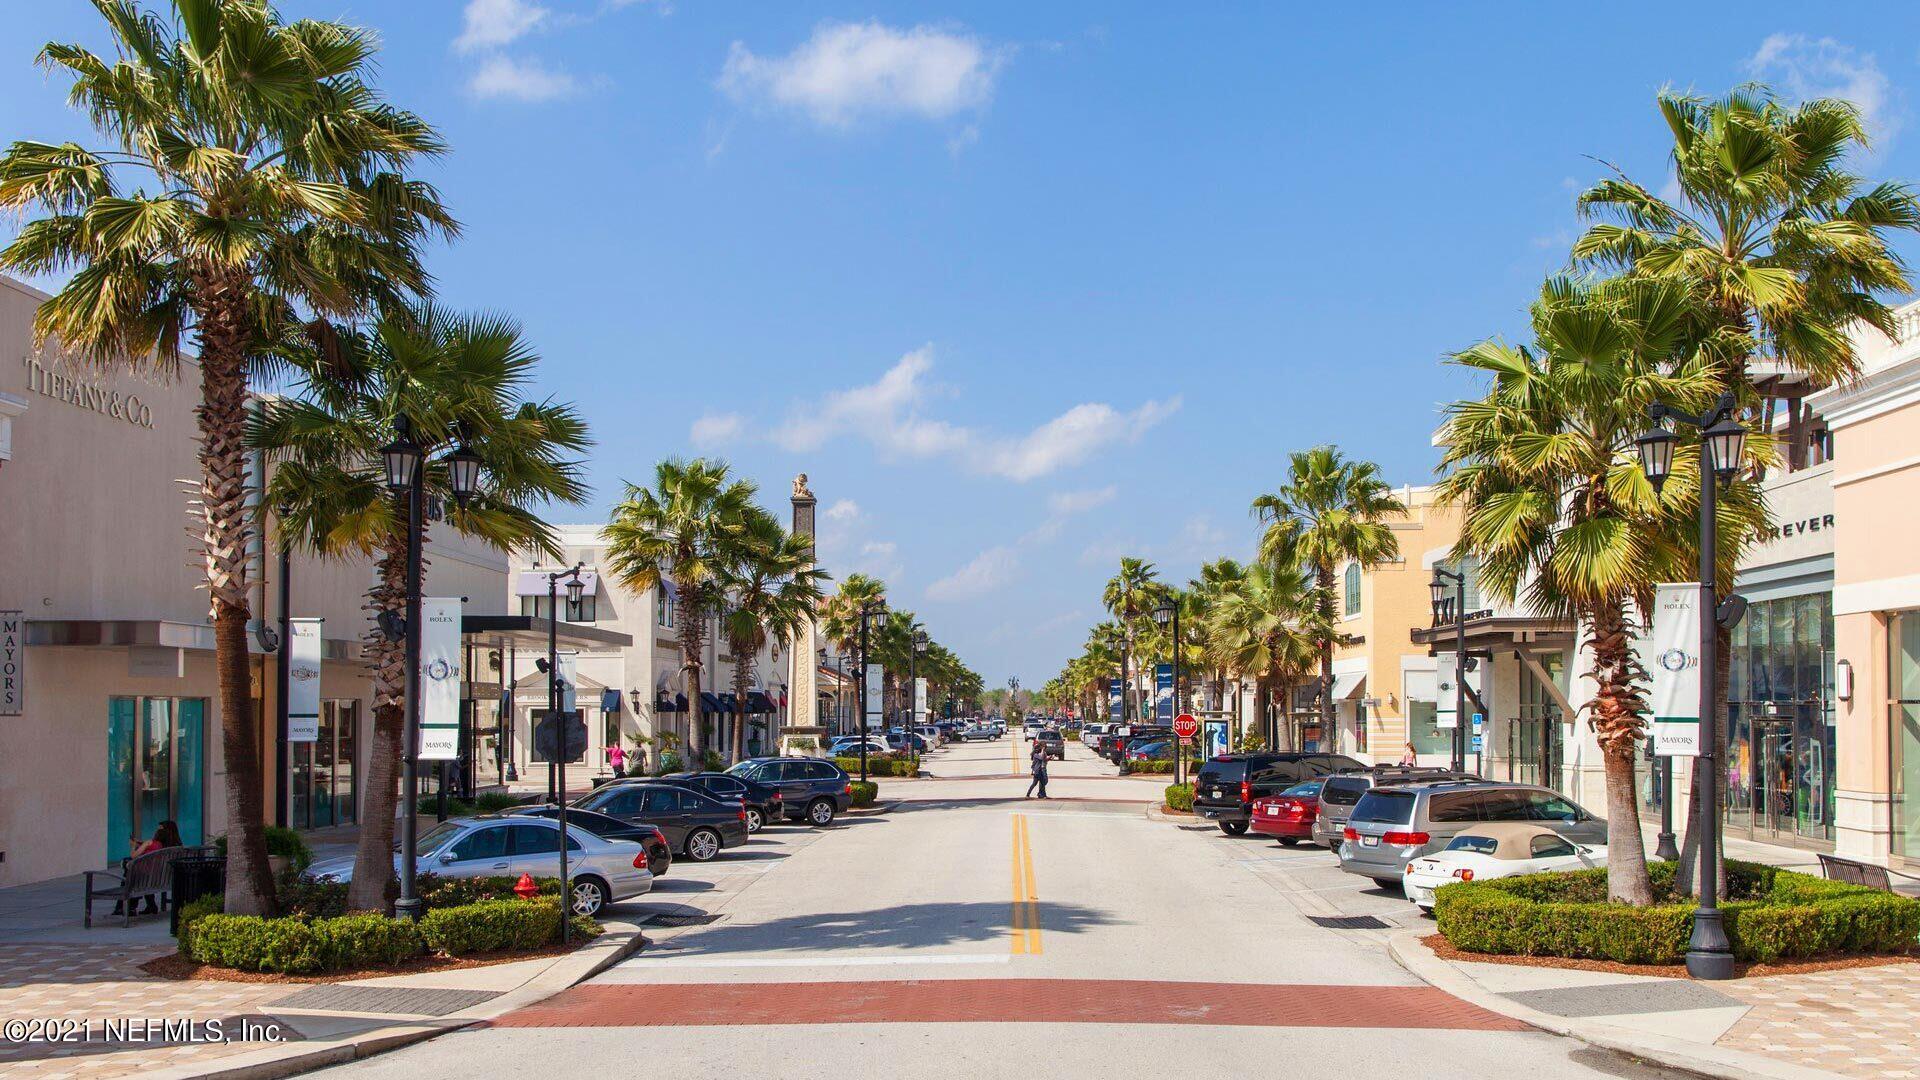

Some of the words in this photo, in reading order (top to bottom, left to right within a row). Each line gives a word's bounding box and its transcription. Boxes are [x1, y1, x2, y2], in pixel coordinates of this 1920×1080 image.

[25, 358, 108, 415] TIFFANY
[3, 620, 17, 704] MAYORS
[1175, 721, 1196, 730] STOP
[1661, 736, 1693, 744] MAYORS
[425, 741, 452, 749] MAYORS
